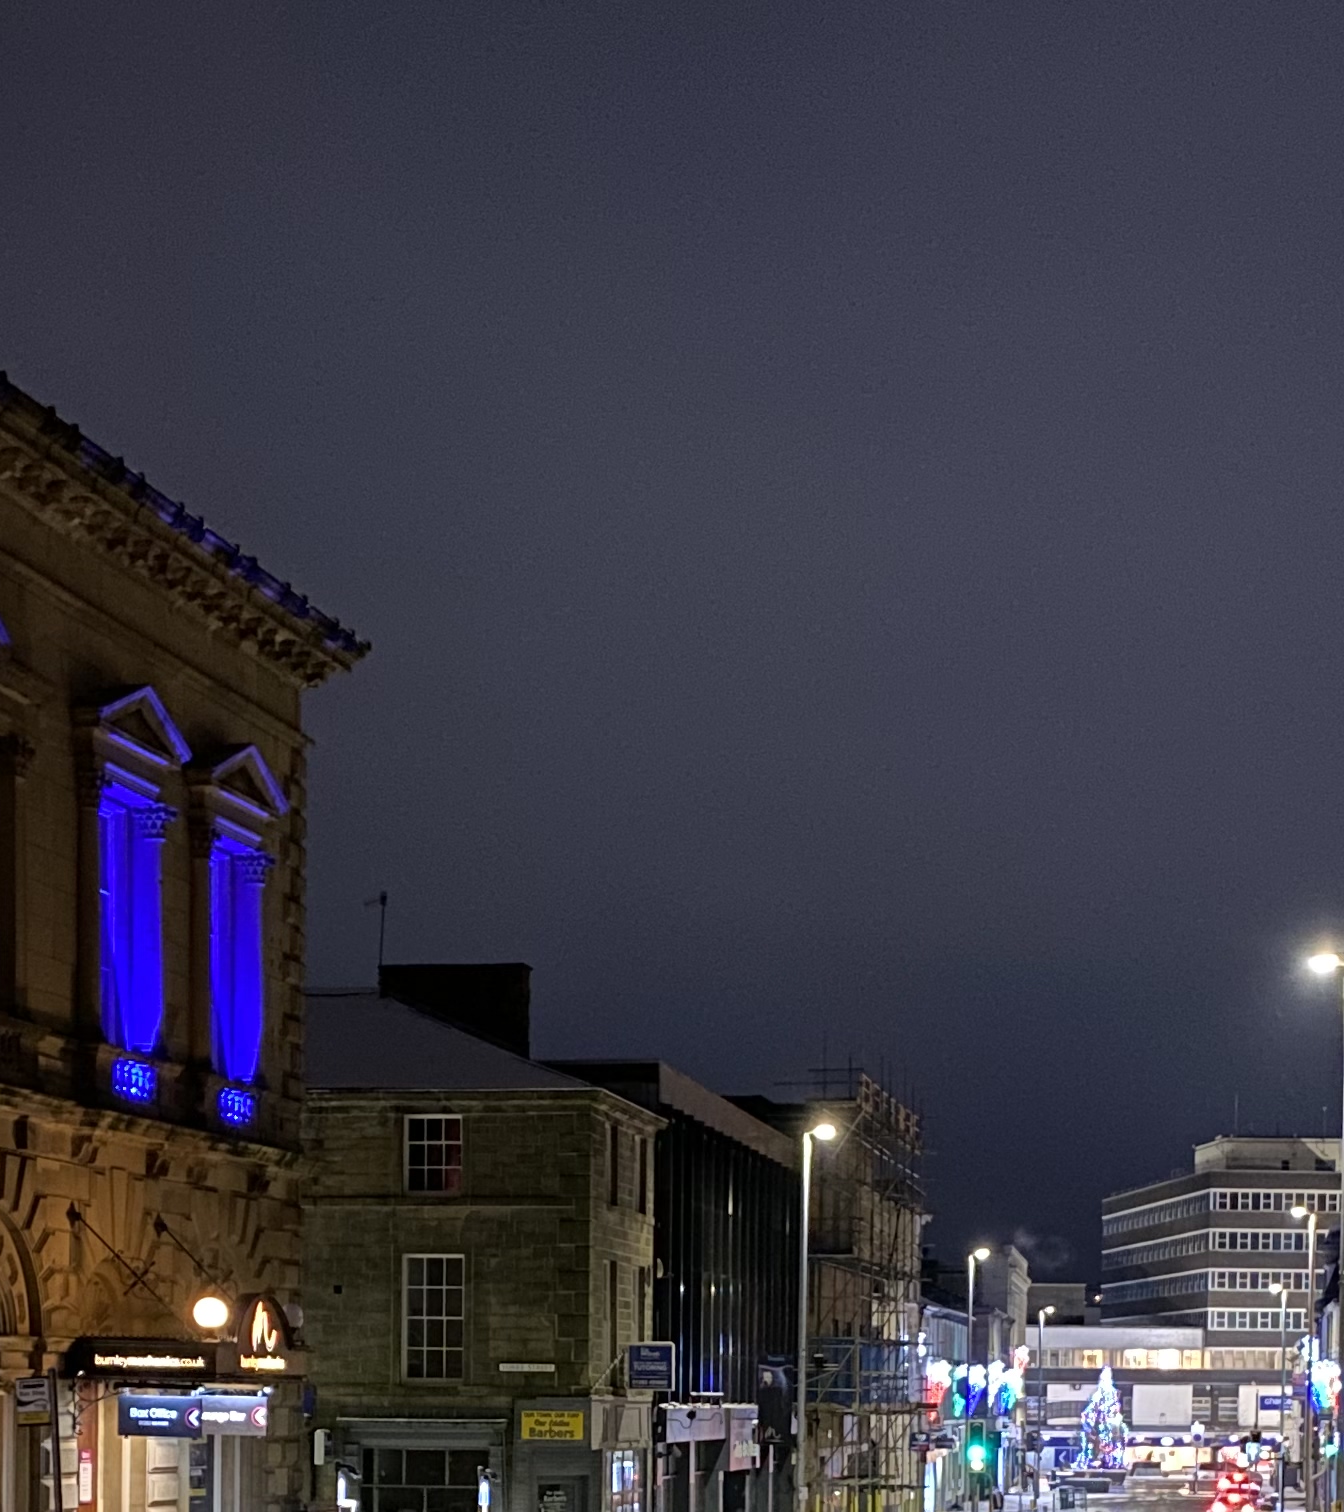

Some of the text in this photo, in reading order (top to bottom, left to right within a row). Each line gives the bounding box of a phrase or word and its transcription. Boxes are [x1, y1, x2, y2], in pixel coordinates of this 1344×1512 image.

[129, 1407, 178, 1419] Box Office
[528, 1427, 575, 1438] Barbers
